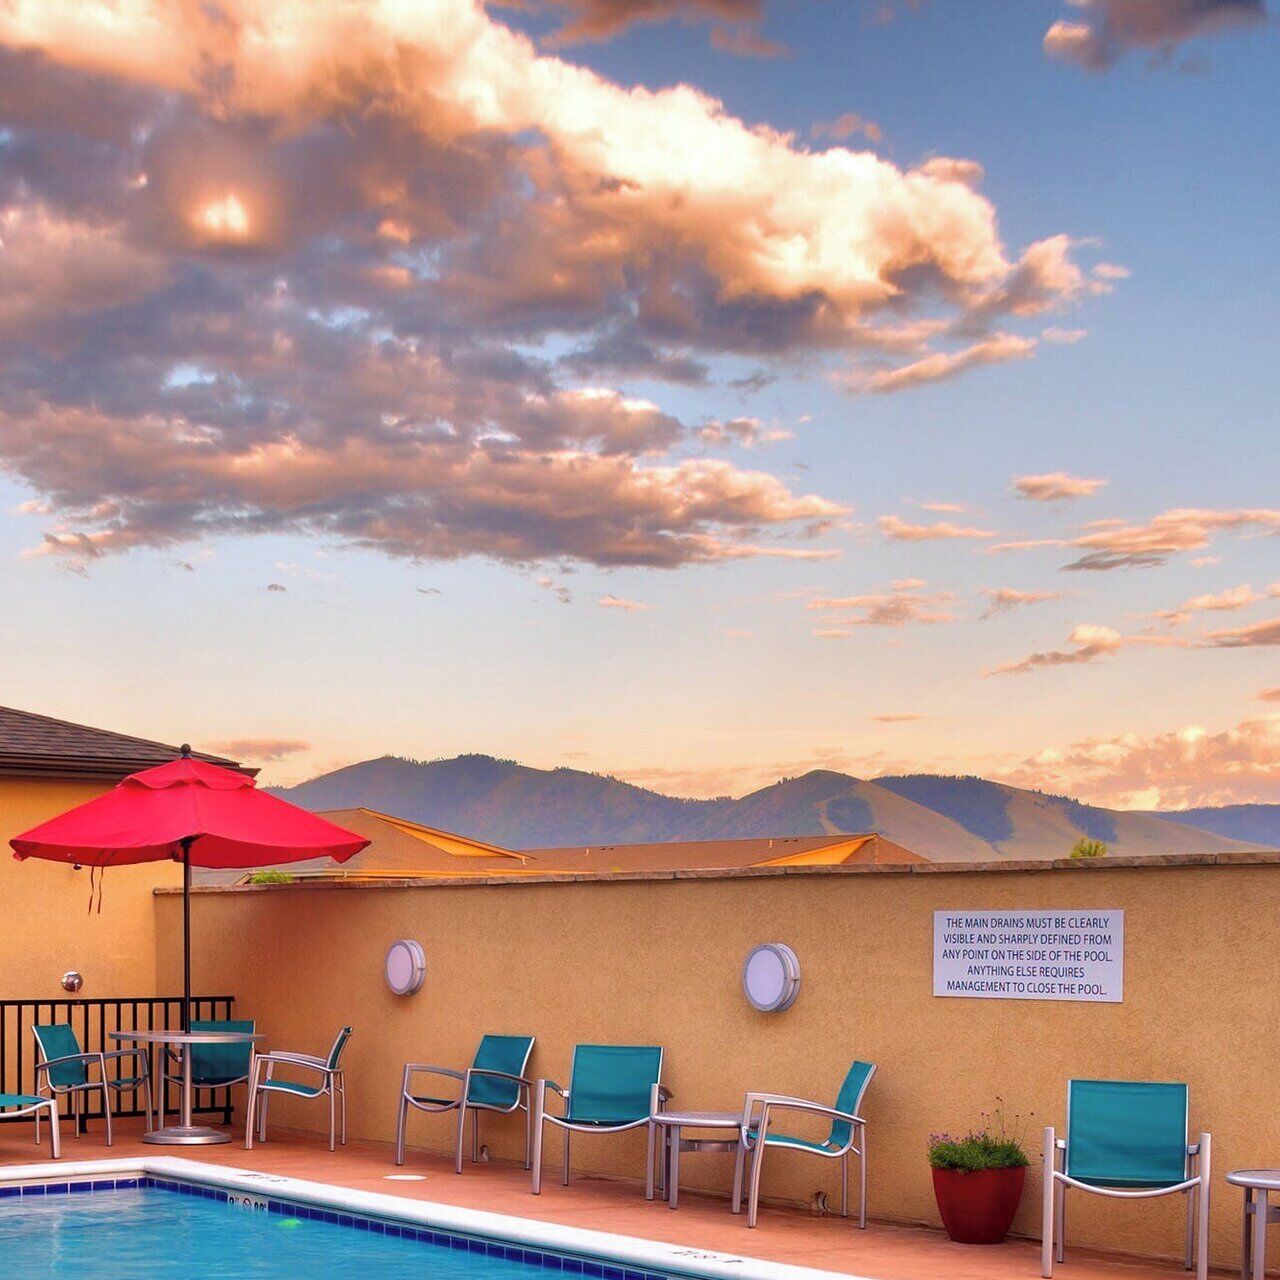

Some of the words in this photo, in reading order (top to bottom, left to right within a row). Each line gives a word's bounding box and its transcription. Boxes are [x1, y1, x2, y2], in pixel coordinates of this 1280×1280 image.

[946, 918, 963, 928] THE
[964, 918, 989, 928] MAIN
[990, 918, 1024, 929] DRAINS
[1026, 918, 1052, 929] MUST
[1054, 918, 1066, 929] BE
[1068, 918, 1109, 929] CLEARLY
[943, 934, 975, 944] VISIBLE
[976, 934, 997, 944] AND
[998, 934, 1039, 945] SHARPLY
[1040, 934, 1081, 945] DEFINED
[1083, 934, 1112, 945] FROM
[942, 949, 961, 959] ANY
[962, 949, 989, 960] POINT
[991, 950, 1005, 960] ON
[1007, 950, 1025, 961] THE
[1026, 950, 1047, 961] SIDE
[1048, 951, 1062, 961] OF
[1063, 951, 1082, 962] THE
[1084, 951, 1114, 962] POOL.
[967, 965, 1014, 976] ANYTHING
[1016, 966, 1037, 977] ELSE
[1040, 967, 1085, 979] REQUIRES
[946, 981, 1011, 992] MANAGEMENT
[1013, 982, 1025, 993] TO
[1027, 982, 1056, 994] CLOSE
[1057, 983, 1076, 995] THE
[1077, 984, 1107, 996] POOL.
